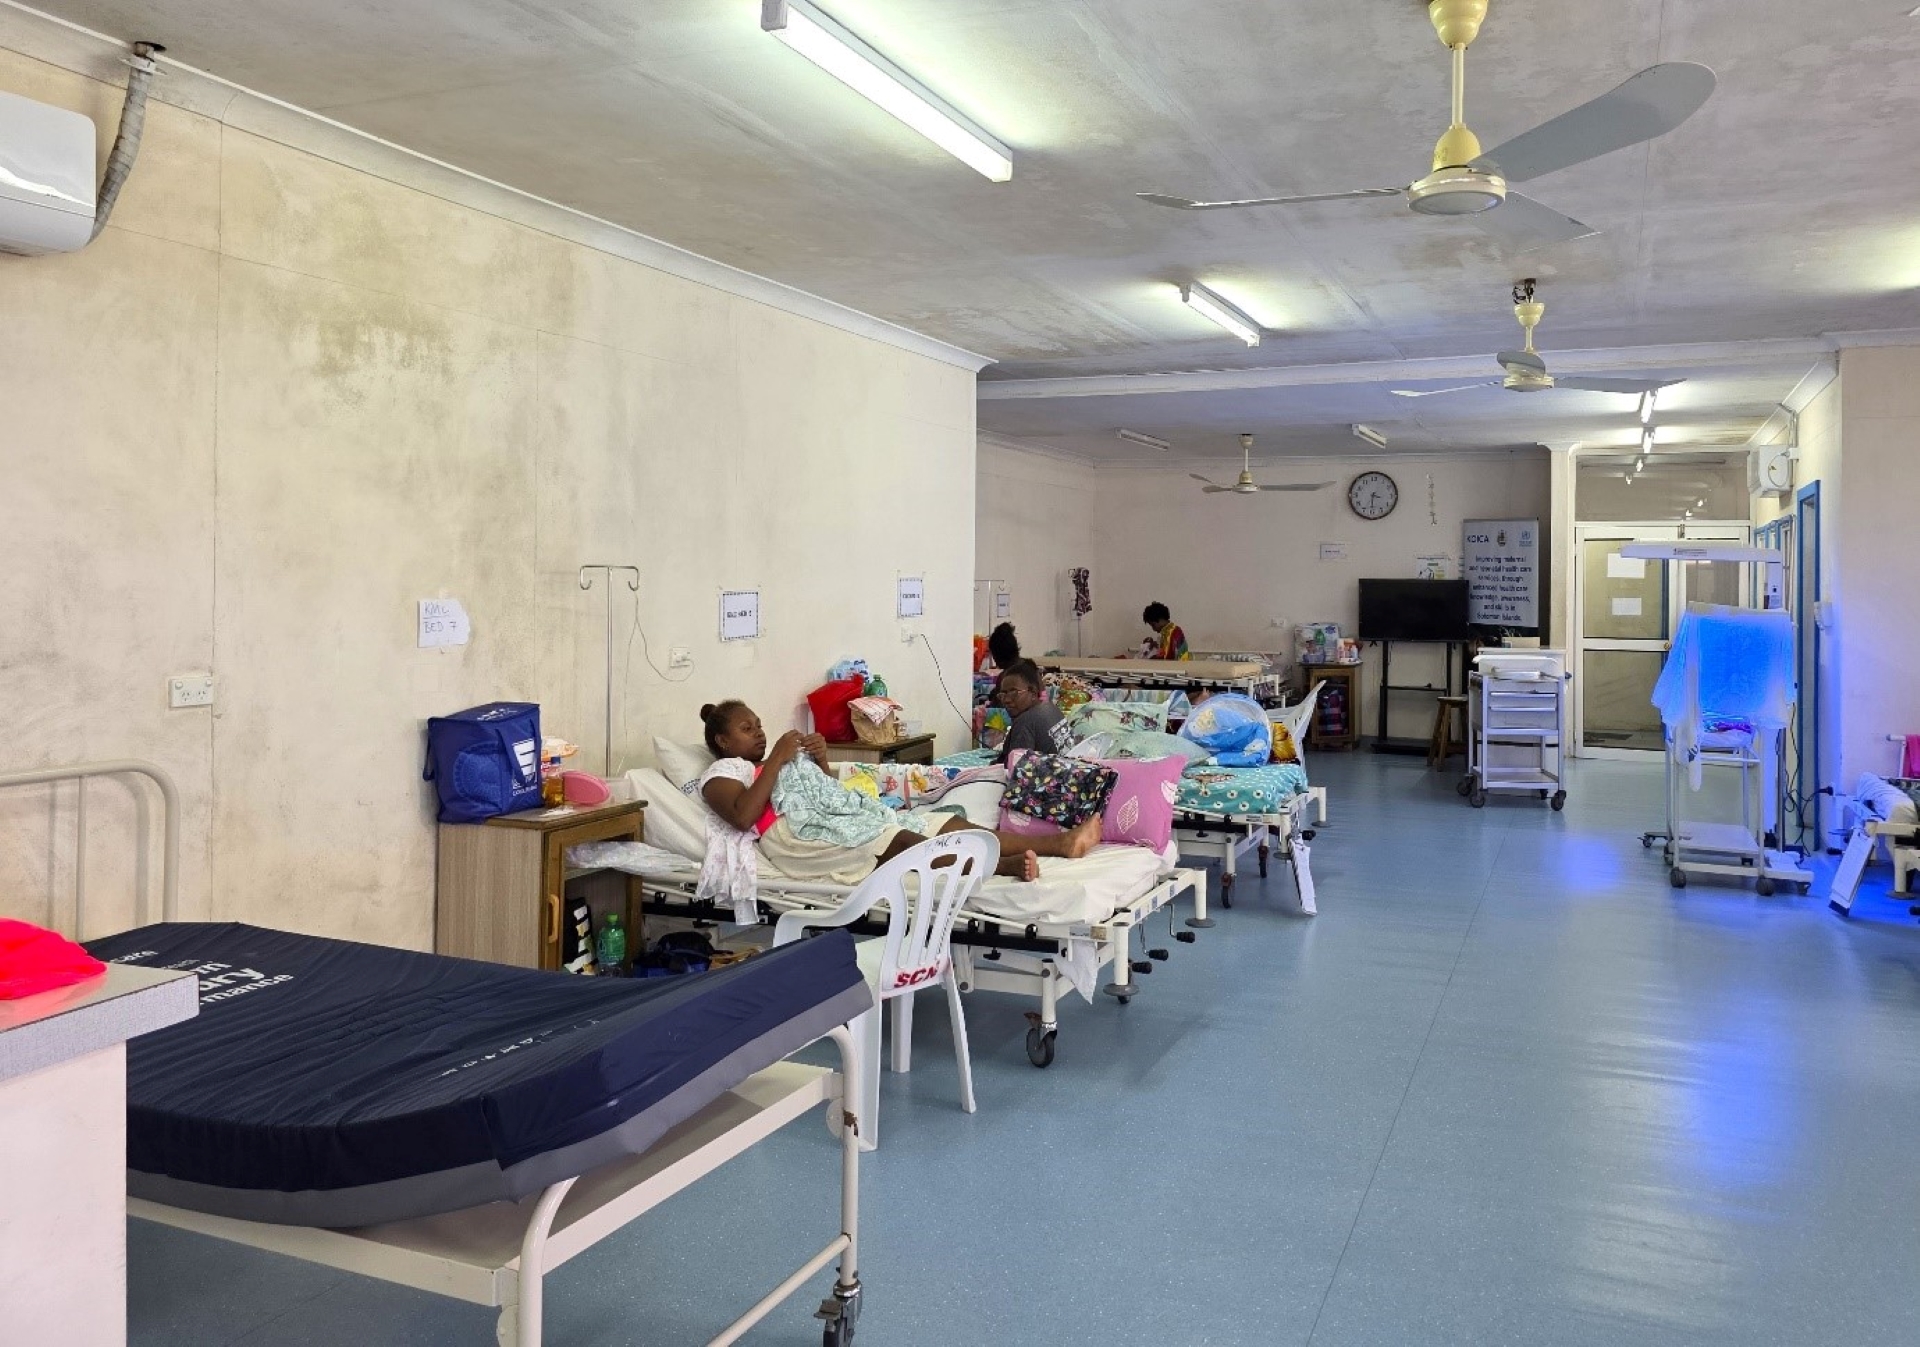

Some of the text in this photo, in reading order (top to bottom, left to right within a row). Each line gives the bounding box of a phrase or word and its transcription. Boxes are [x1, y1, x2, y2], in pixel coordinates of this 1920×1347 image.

[423, 621, 457, 634] BED 7
[199, 974, 295, 1006] mance
